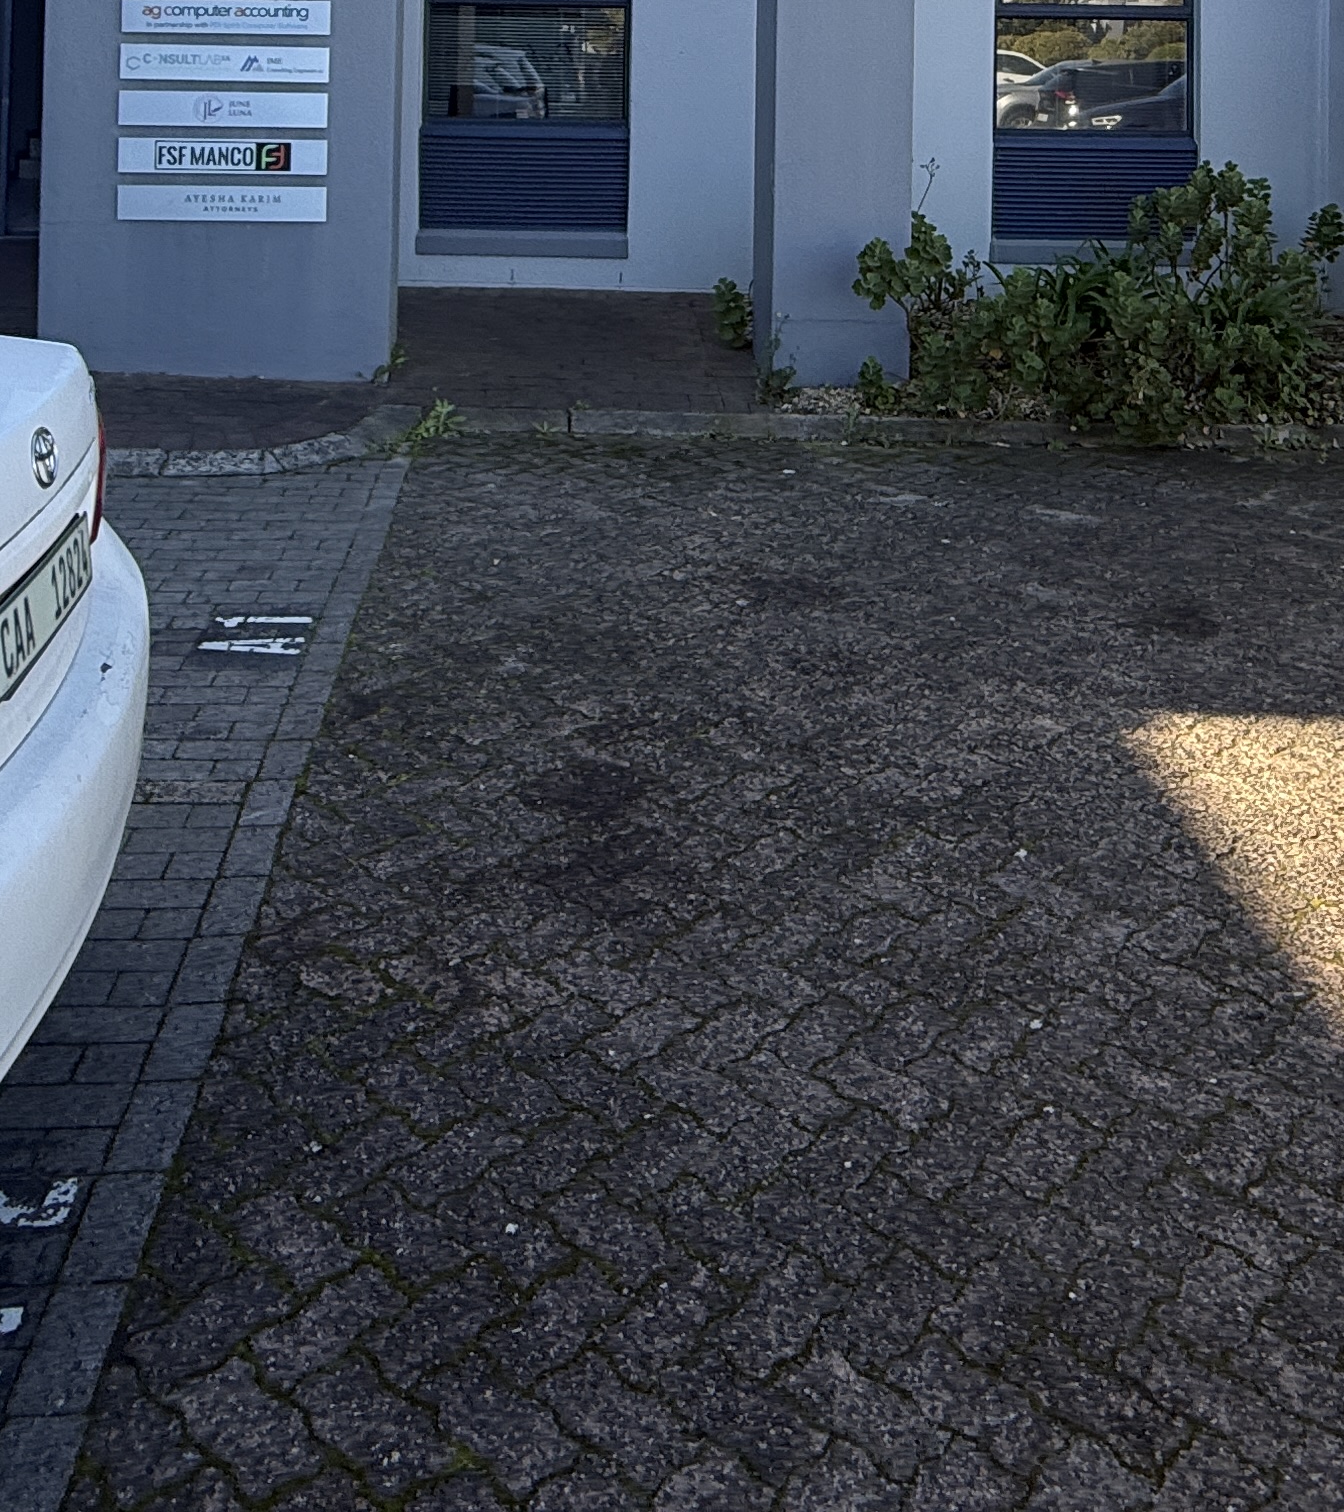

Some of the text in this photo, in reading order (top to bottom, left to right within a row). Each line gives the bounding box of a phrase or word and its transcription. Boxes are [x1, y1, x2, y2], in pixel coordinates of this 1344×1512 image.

[142, 4, 309, 22] ag computer accounting
[158, 145, 187, 166] FSF
[190, 146, 254, 167] MANCO
[184, 194, 282, 204] AYESHA KARIM
[202, 205, 259, 213] ATTORNEYS
[0, 595, 36, 679] CAA
